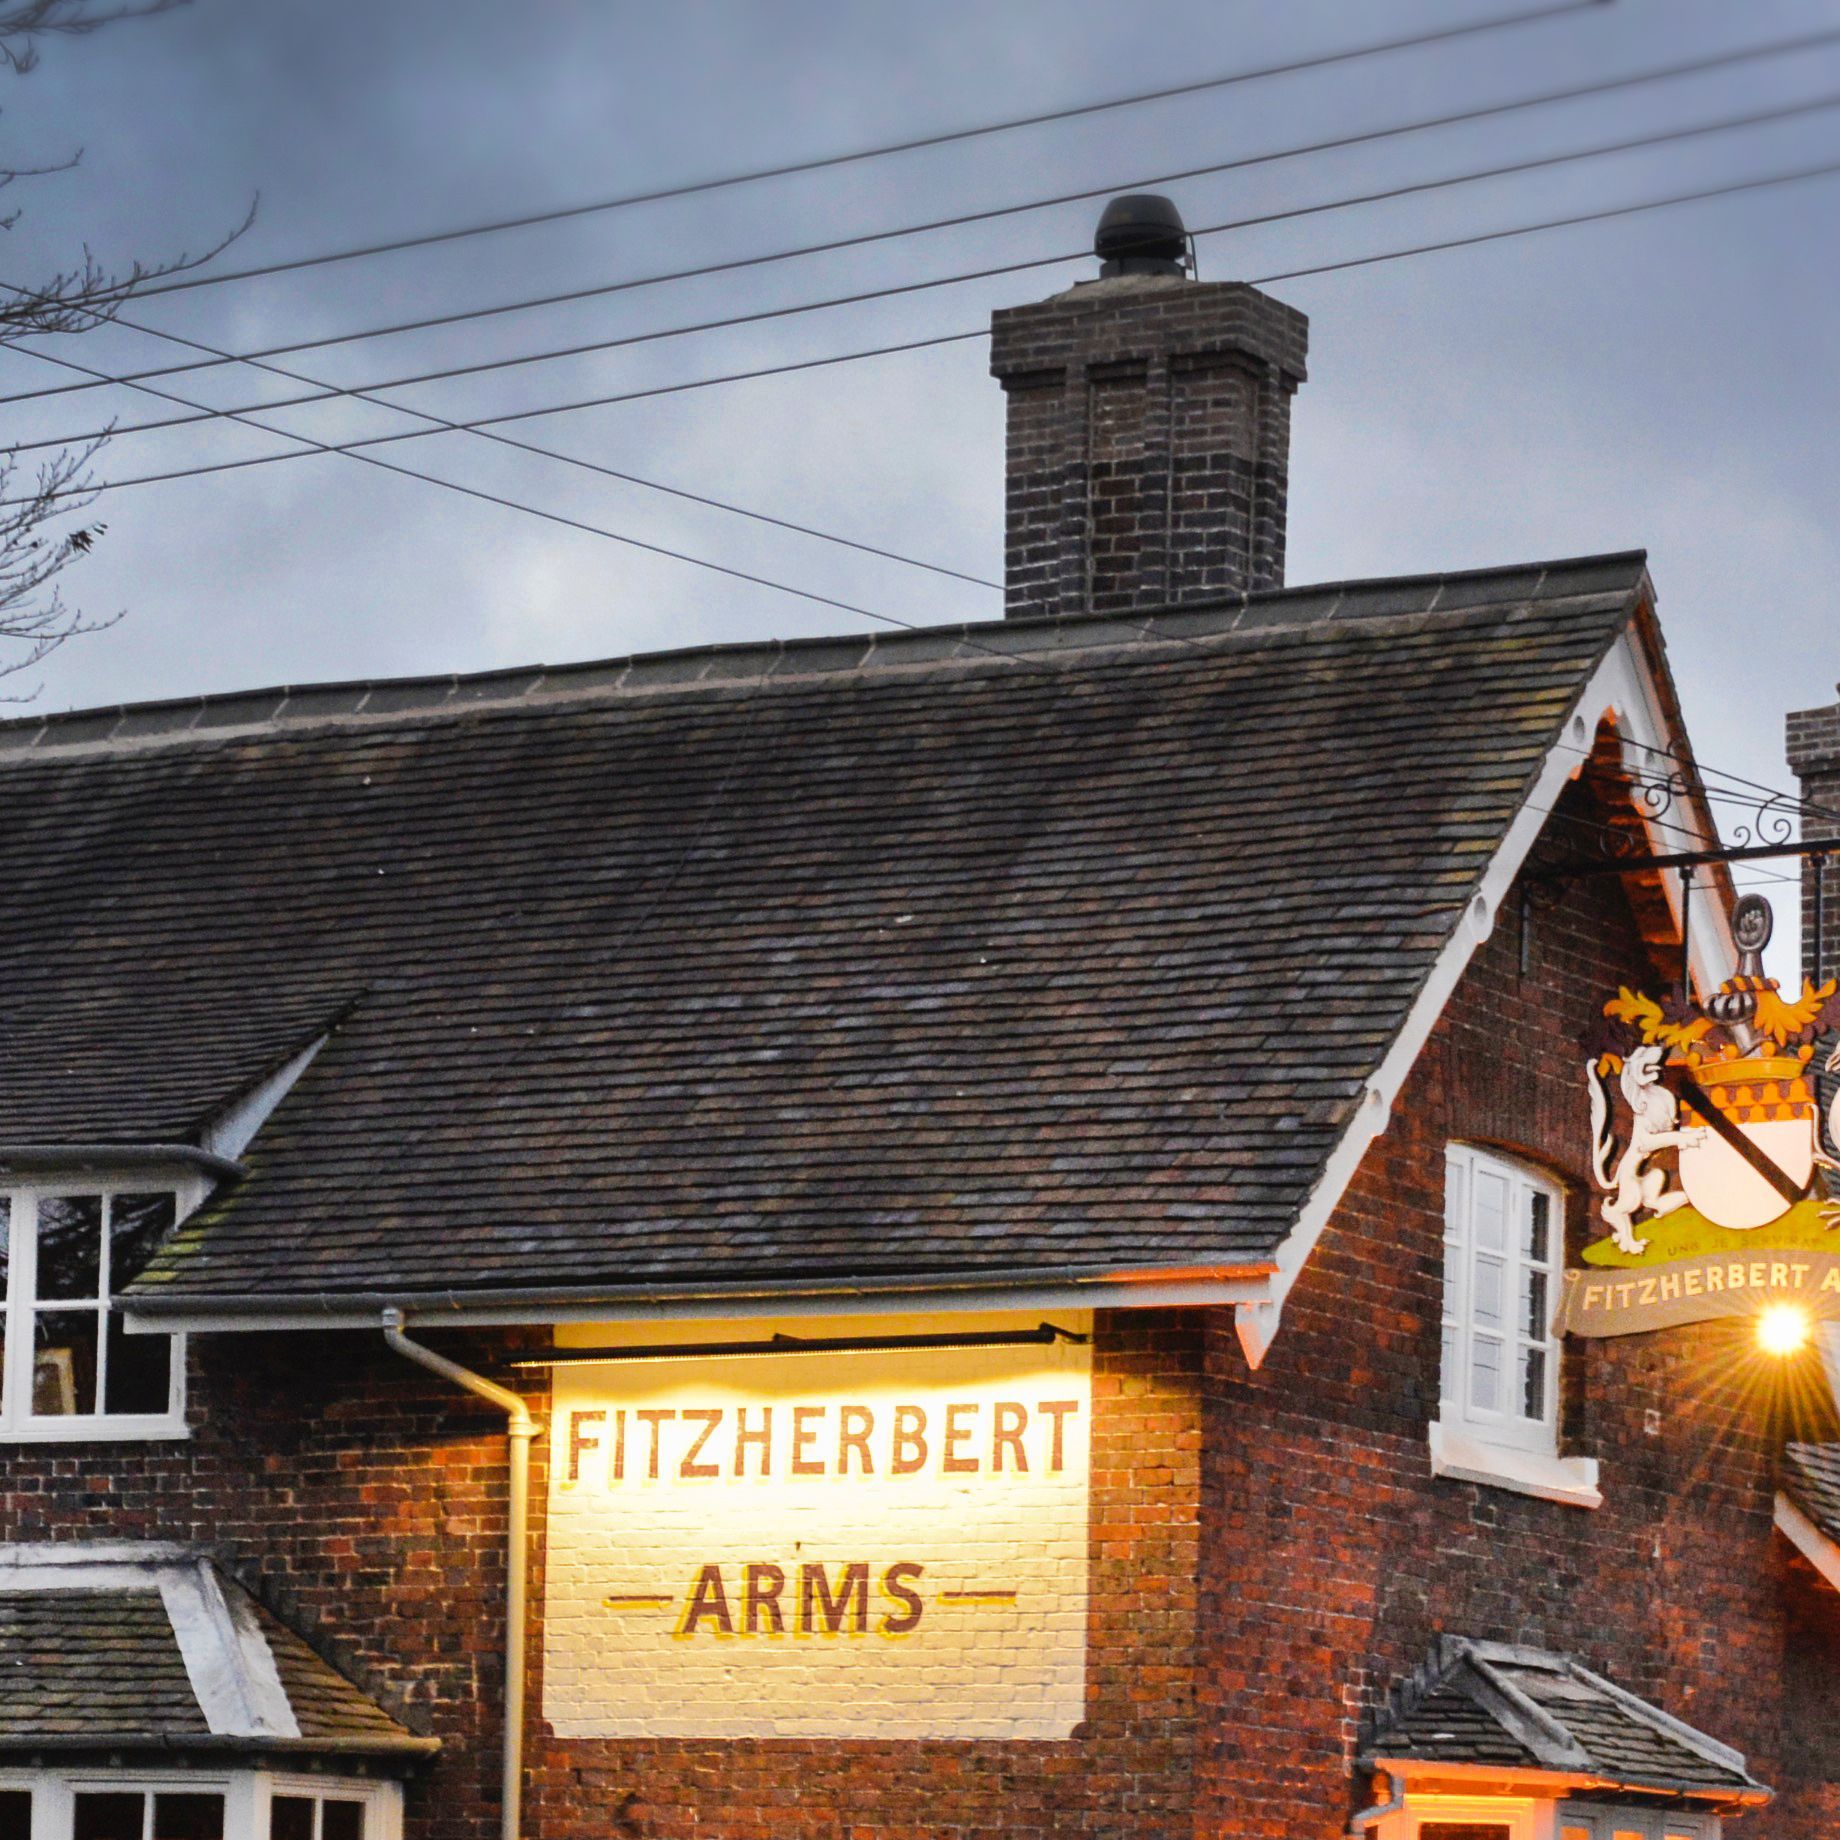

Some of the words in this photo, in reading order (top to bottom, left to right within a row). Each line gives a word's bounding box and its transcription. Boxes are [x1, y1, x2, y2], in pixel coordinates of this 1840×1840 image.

[1582, 1263, 1810, 1311] FITZHERBERT
[565, 1400, 1079, 1481] FITZHERBERT
[678, 1562, 926, 1638] ARMS
